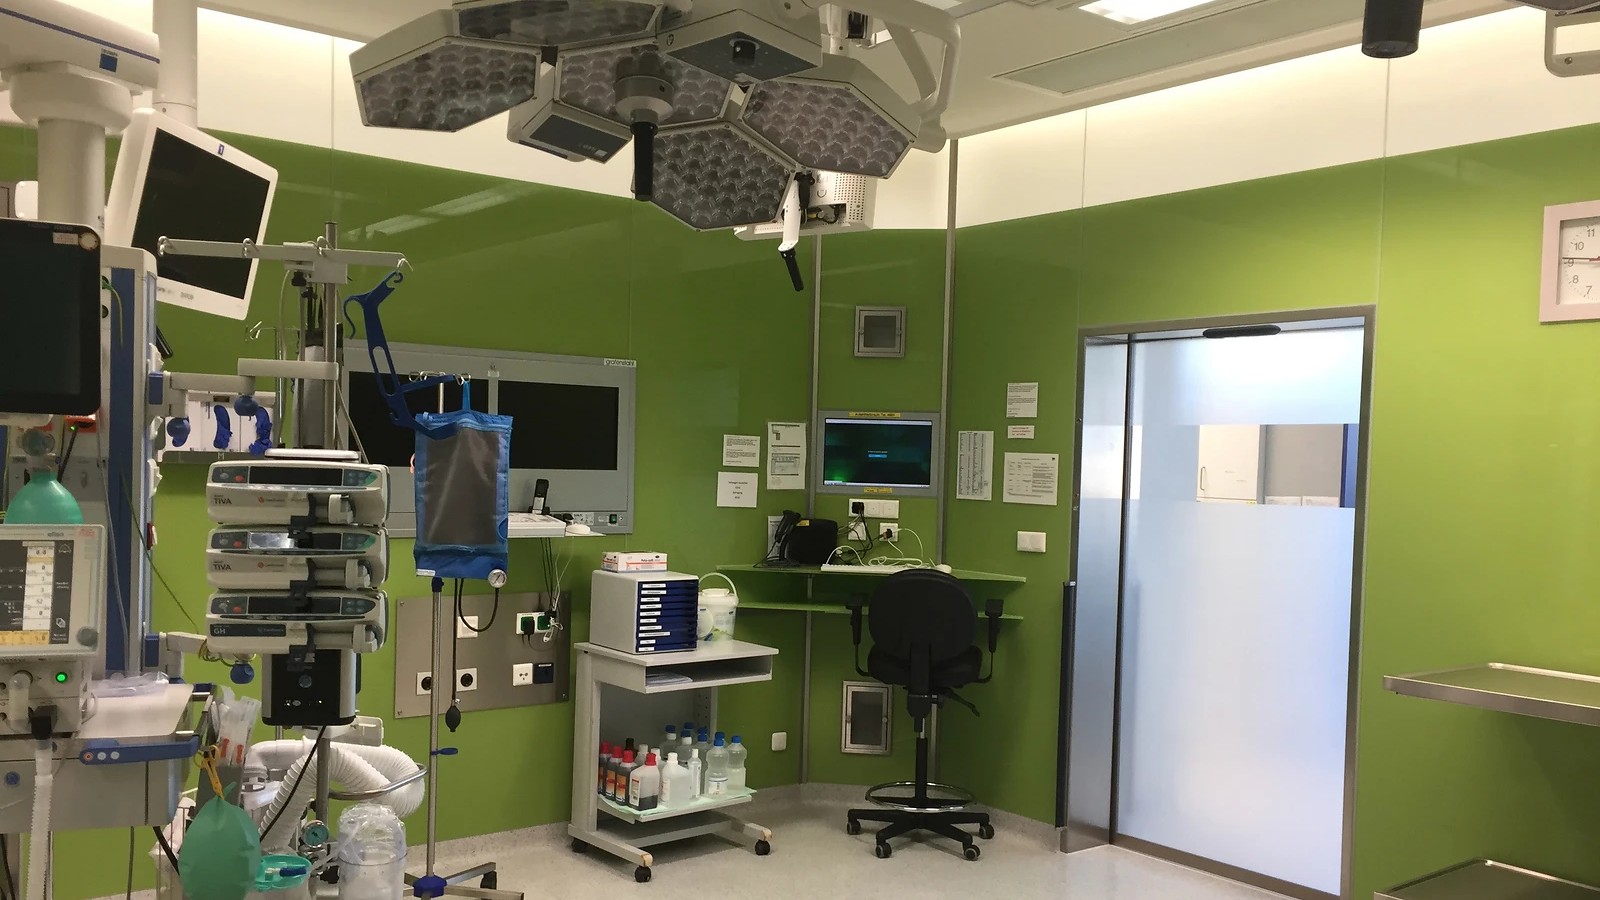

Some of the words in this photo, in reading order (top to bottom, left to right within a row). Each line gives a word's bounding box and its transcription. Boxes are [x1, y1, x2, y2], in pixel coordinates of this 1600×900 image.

[1586, 229, 1595, 237] 11
[1574, 241, 1585, 251] 10
[1567, 258, 1575, 267] 9
[1572, 275, 1579, 284] 8
[1585, 286, 1592, 294] 7
[217, 452, 225, 460] M
[213, 497, 232, 505] TIVA
[212, 563, 232, 571] TIVA
[213, 627, 226, 635] GH
